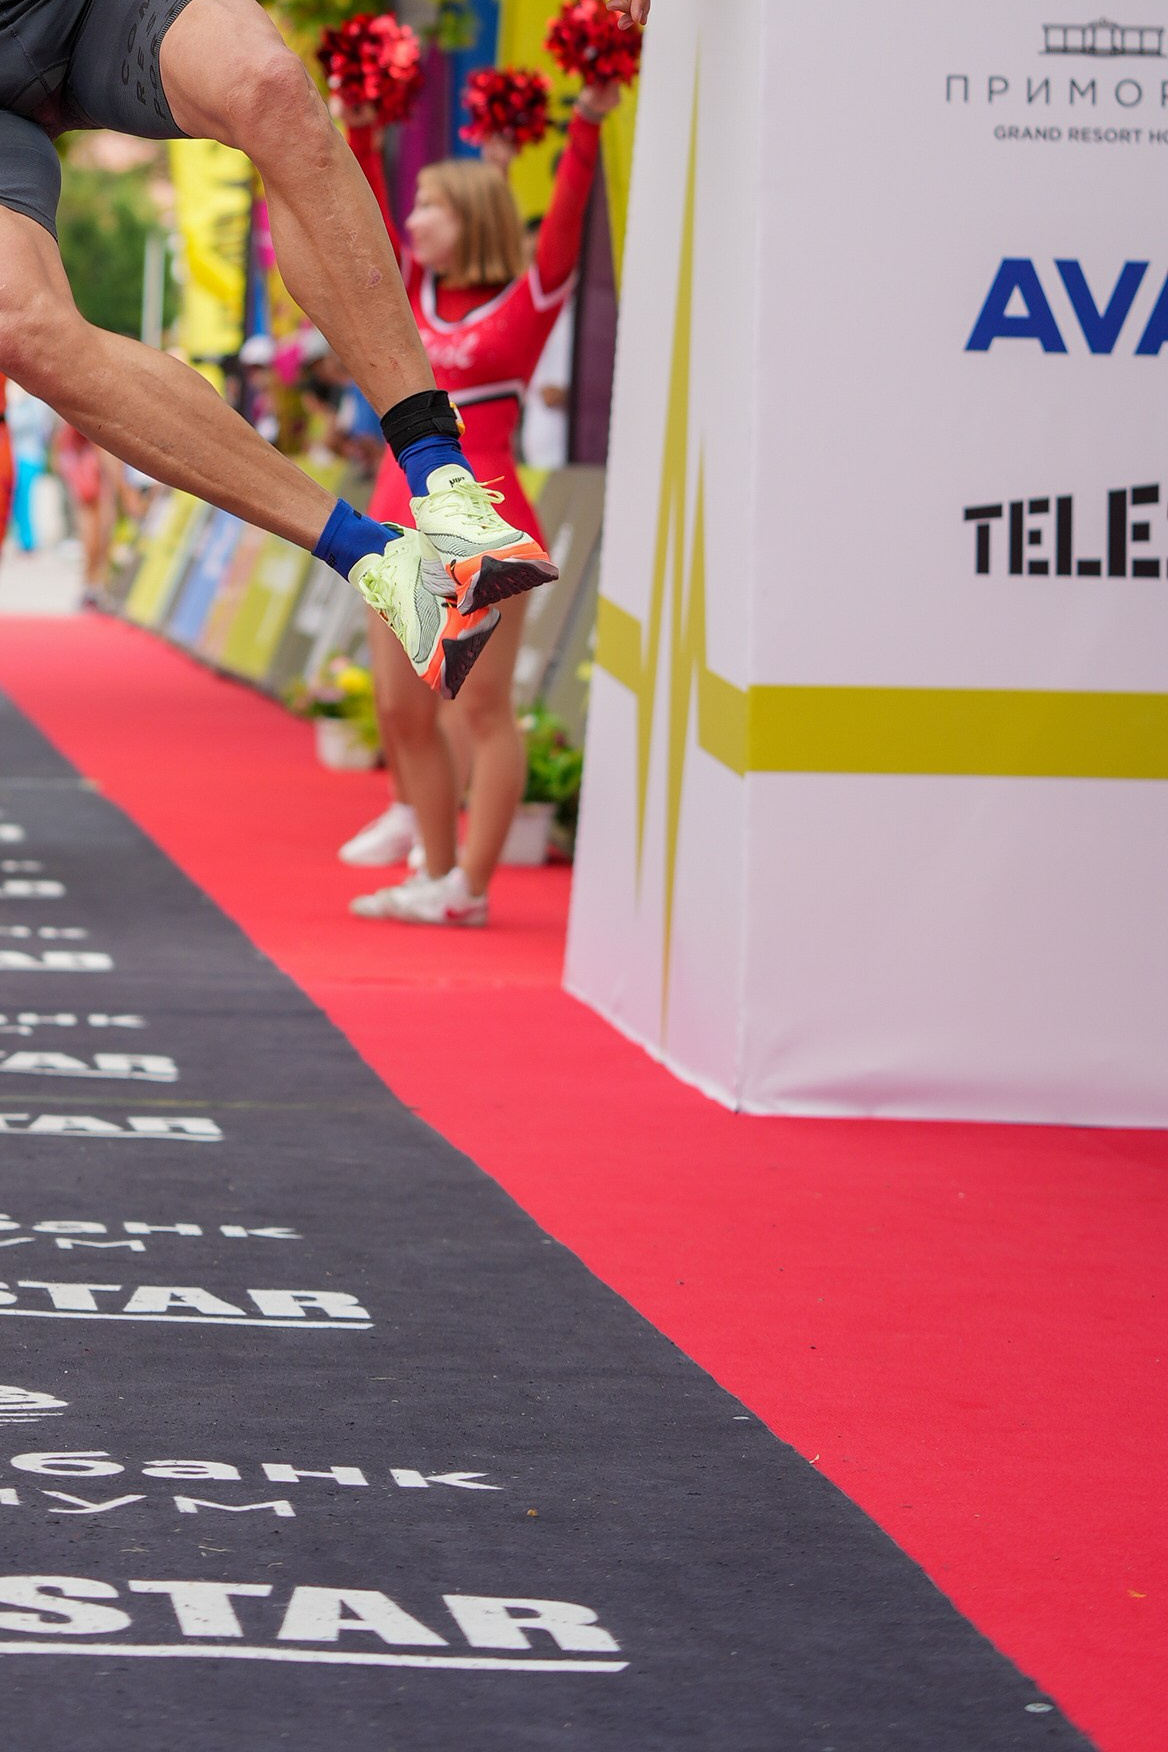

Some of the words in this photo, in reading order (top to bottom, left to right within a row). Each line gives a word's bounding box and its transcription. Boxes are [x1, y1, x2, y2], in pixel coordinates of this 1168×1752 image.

[993, 124, 1062, 144] GRAND
[1068, 127, 1143, 146] RESORT
[964, 482, 1168, 578] TELE
